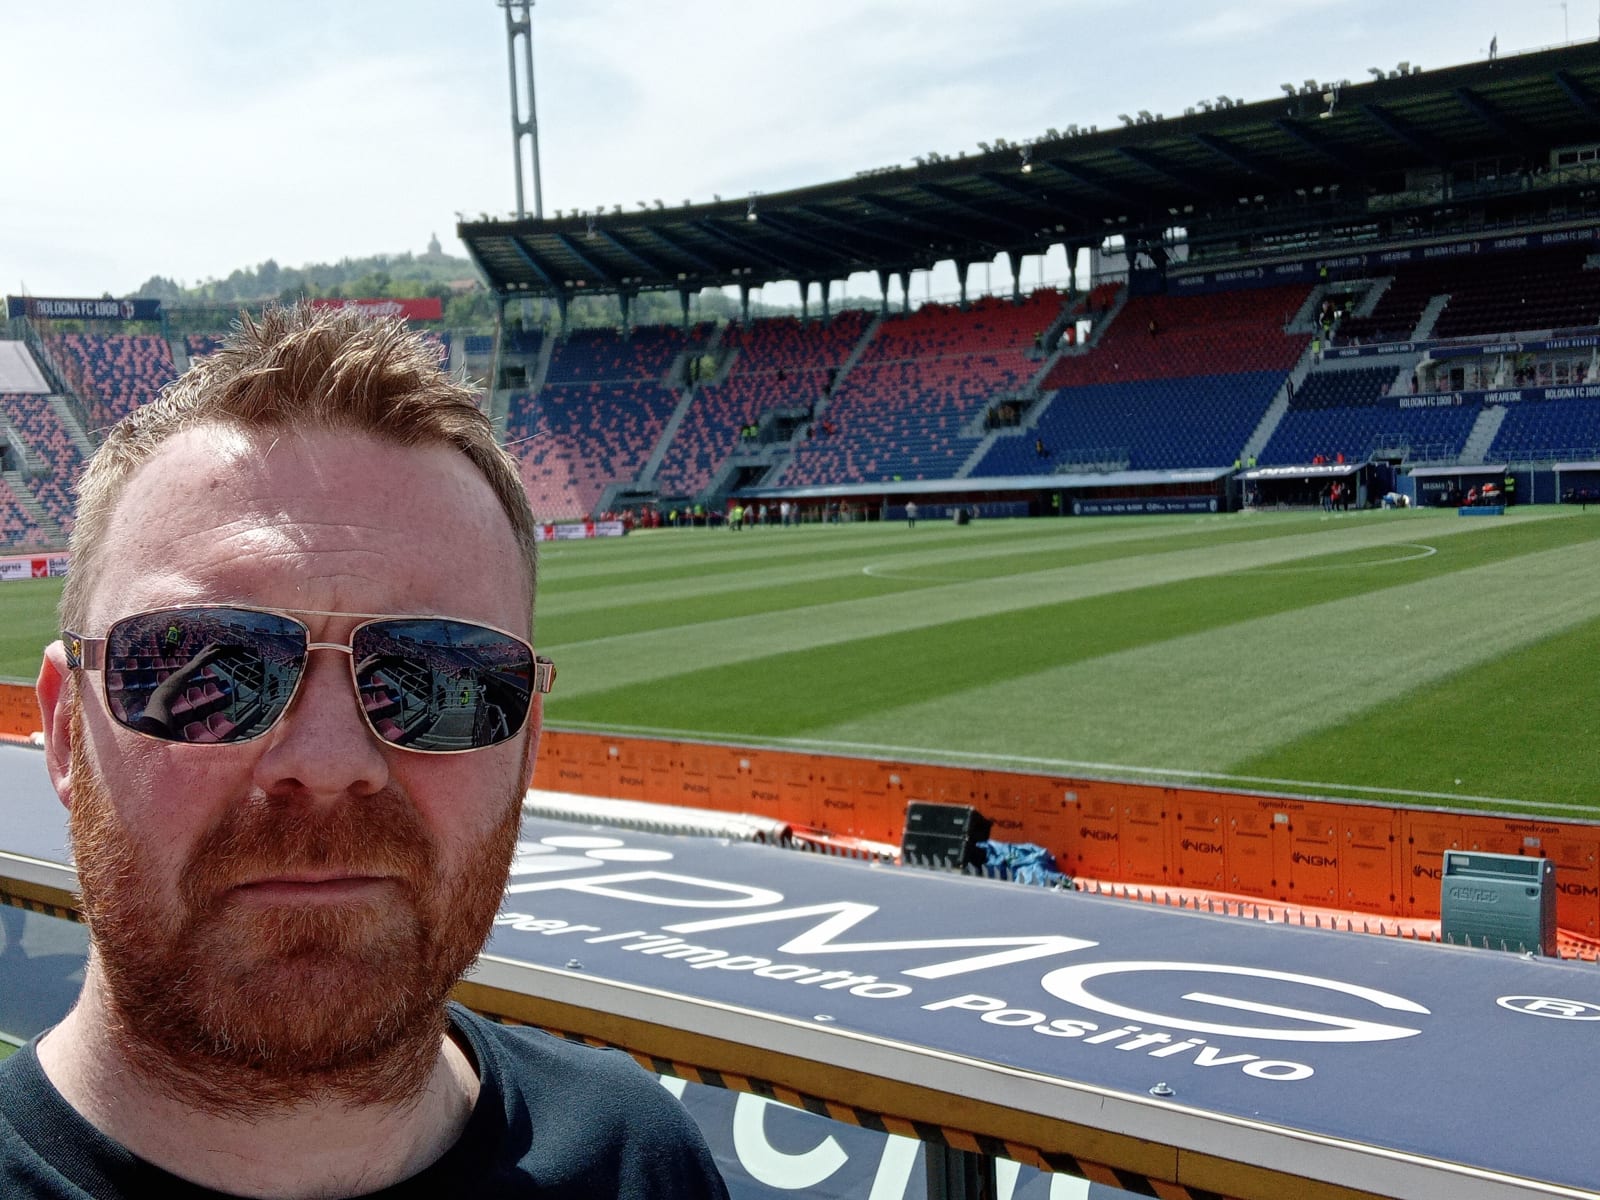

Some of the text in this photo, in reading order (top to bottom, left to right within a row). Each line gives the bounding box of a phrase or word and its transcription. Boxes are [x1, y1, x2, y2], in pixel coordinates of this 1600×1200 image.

[37, 300, 80, 316] BOLOGNA
[81, 301, 93, 316] FC
[1545, 387, 1575, 400] BOLOGNA
[1576, 387, 1585, 398] FC
[1400, 397, 1426, 408] BOLOGNA
[1428, 396, 1436, 406] FC
[1088, 830, 1119, 842] NGM
[1190, 842, 1223, 855] NGM
[1300, 855, 1338, 869] NGM
[1556, 882, 1599, 898] NGM
[920, 994, 1315, 1081] Positivo
